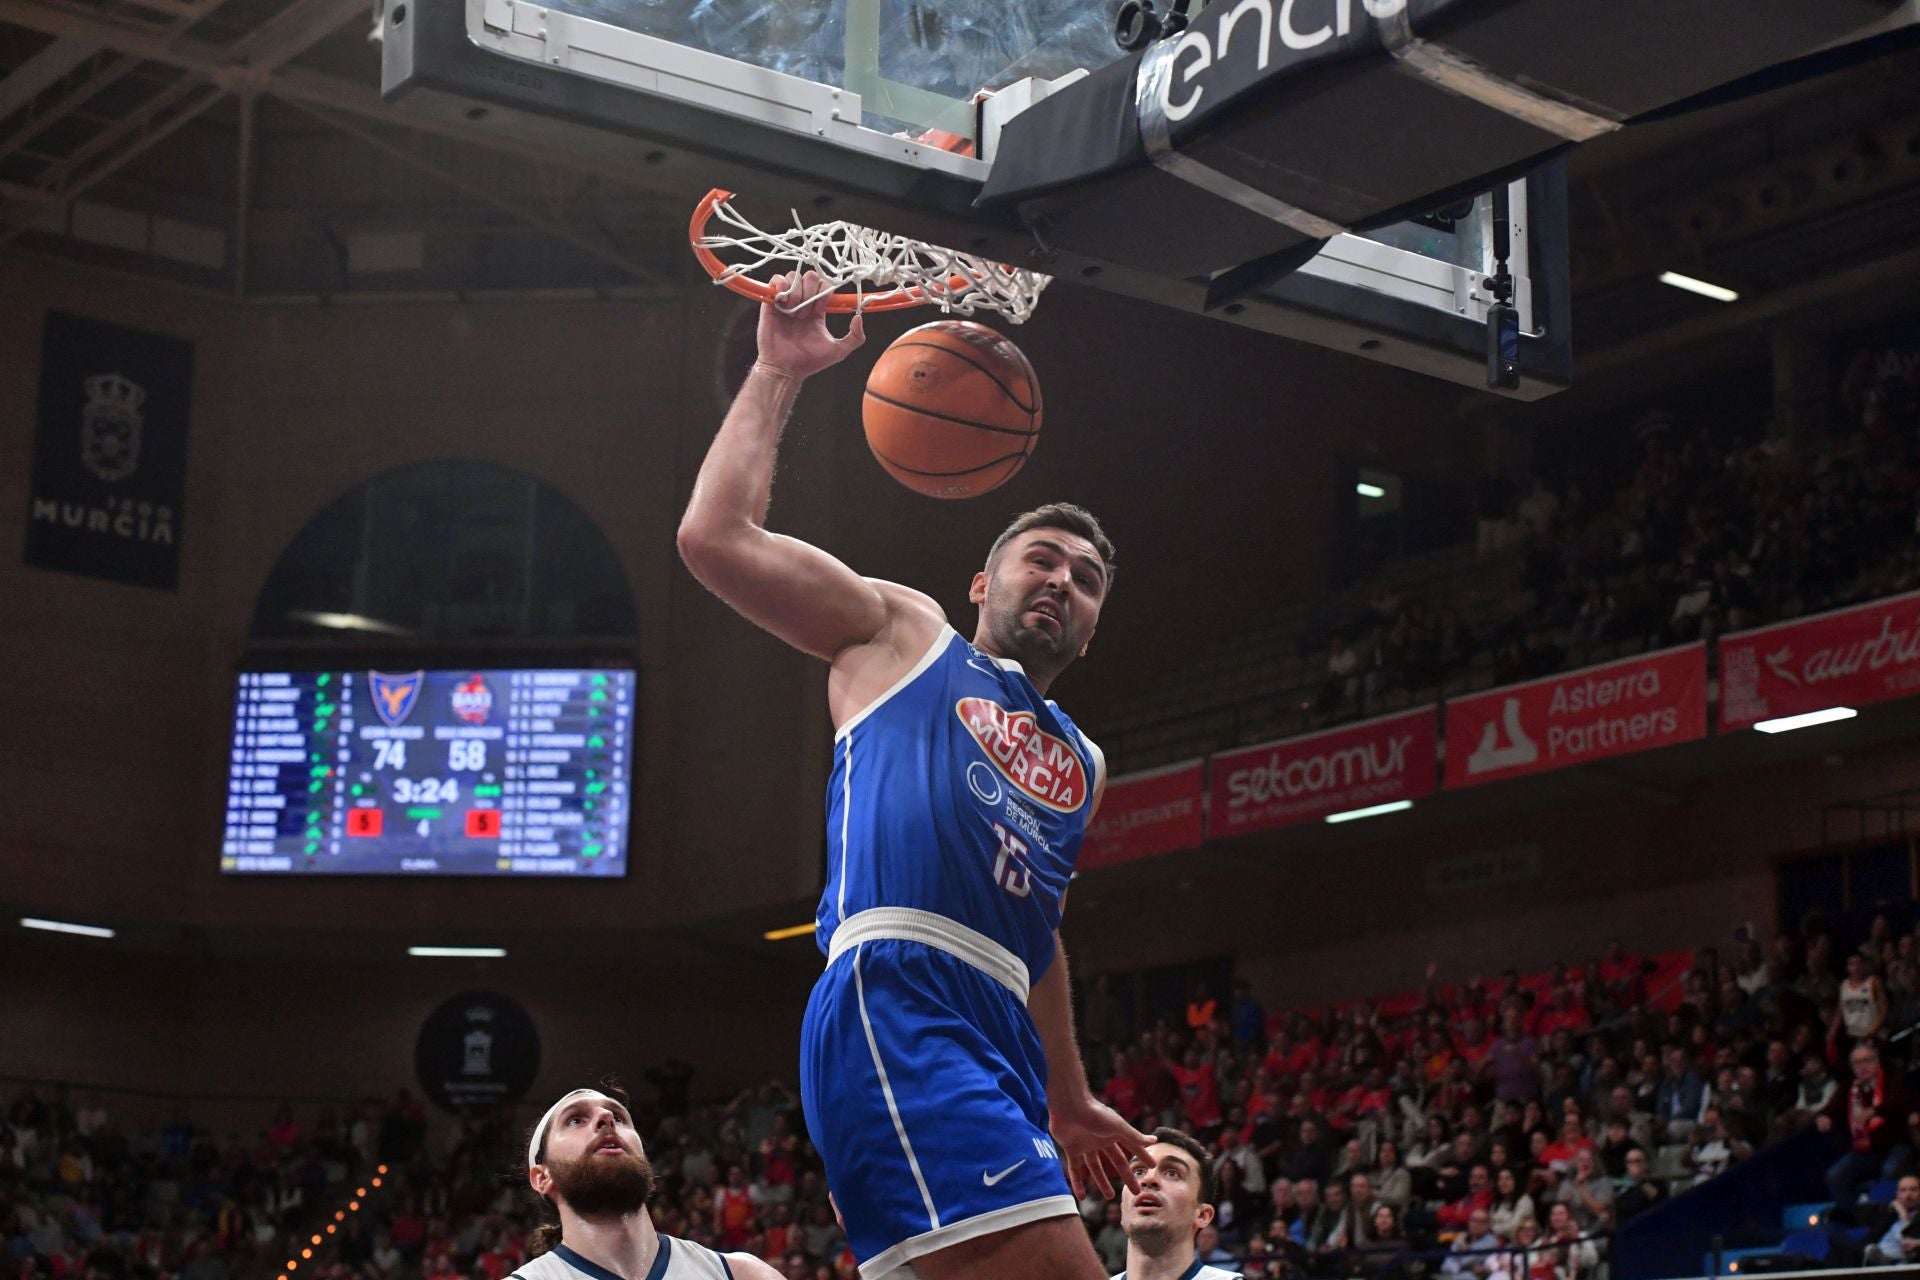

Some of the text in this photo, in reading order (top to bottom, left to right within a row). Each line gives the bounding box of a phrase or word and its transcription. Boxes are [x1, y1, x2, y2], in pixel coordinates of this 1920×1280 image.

[32, 498, 172, 544] MURCIA
[1548, 668, 1661, 717] Asterra
[371, 739, 406, 771] 74
[448, 739, 486, 771] 58
[990, 707, 1074, 778] UCAM
[1548, 706, 1678, 759] Partners
[970, 715, 1073, 805] MURCIA
[1227, 735, 1413, 807] setcomur
[392, 777, 458, 804] 3:24
[416, 819, 430, 838] 4
[1006, 805, 1051, 854] DE MURCIA
[993, 822, 1031, 898] 15
